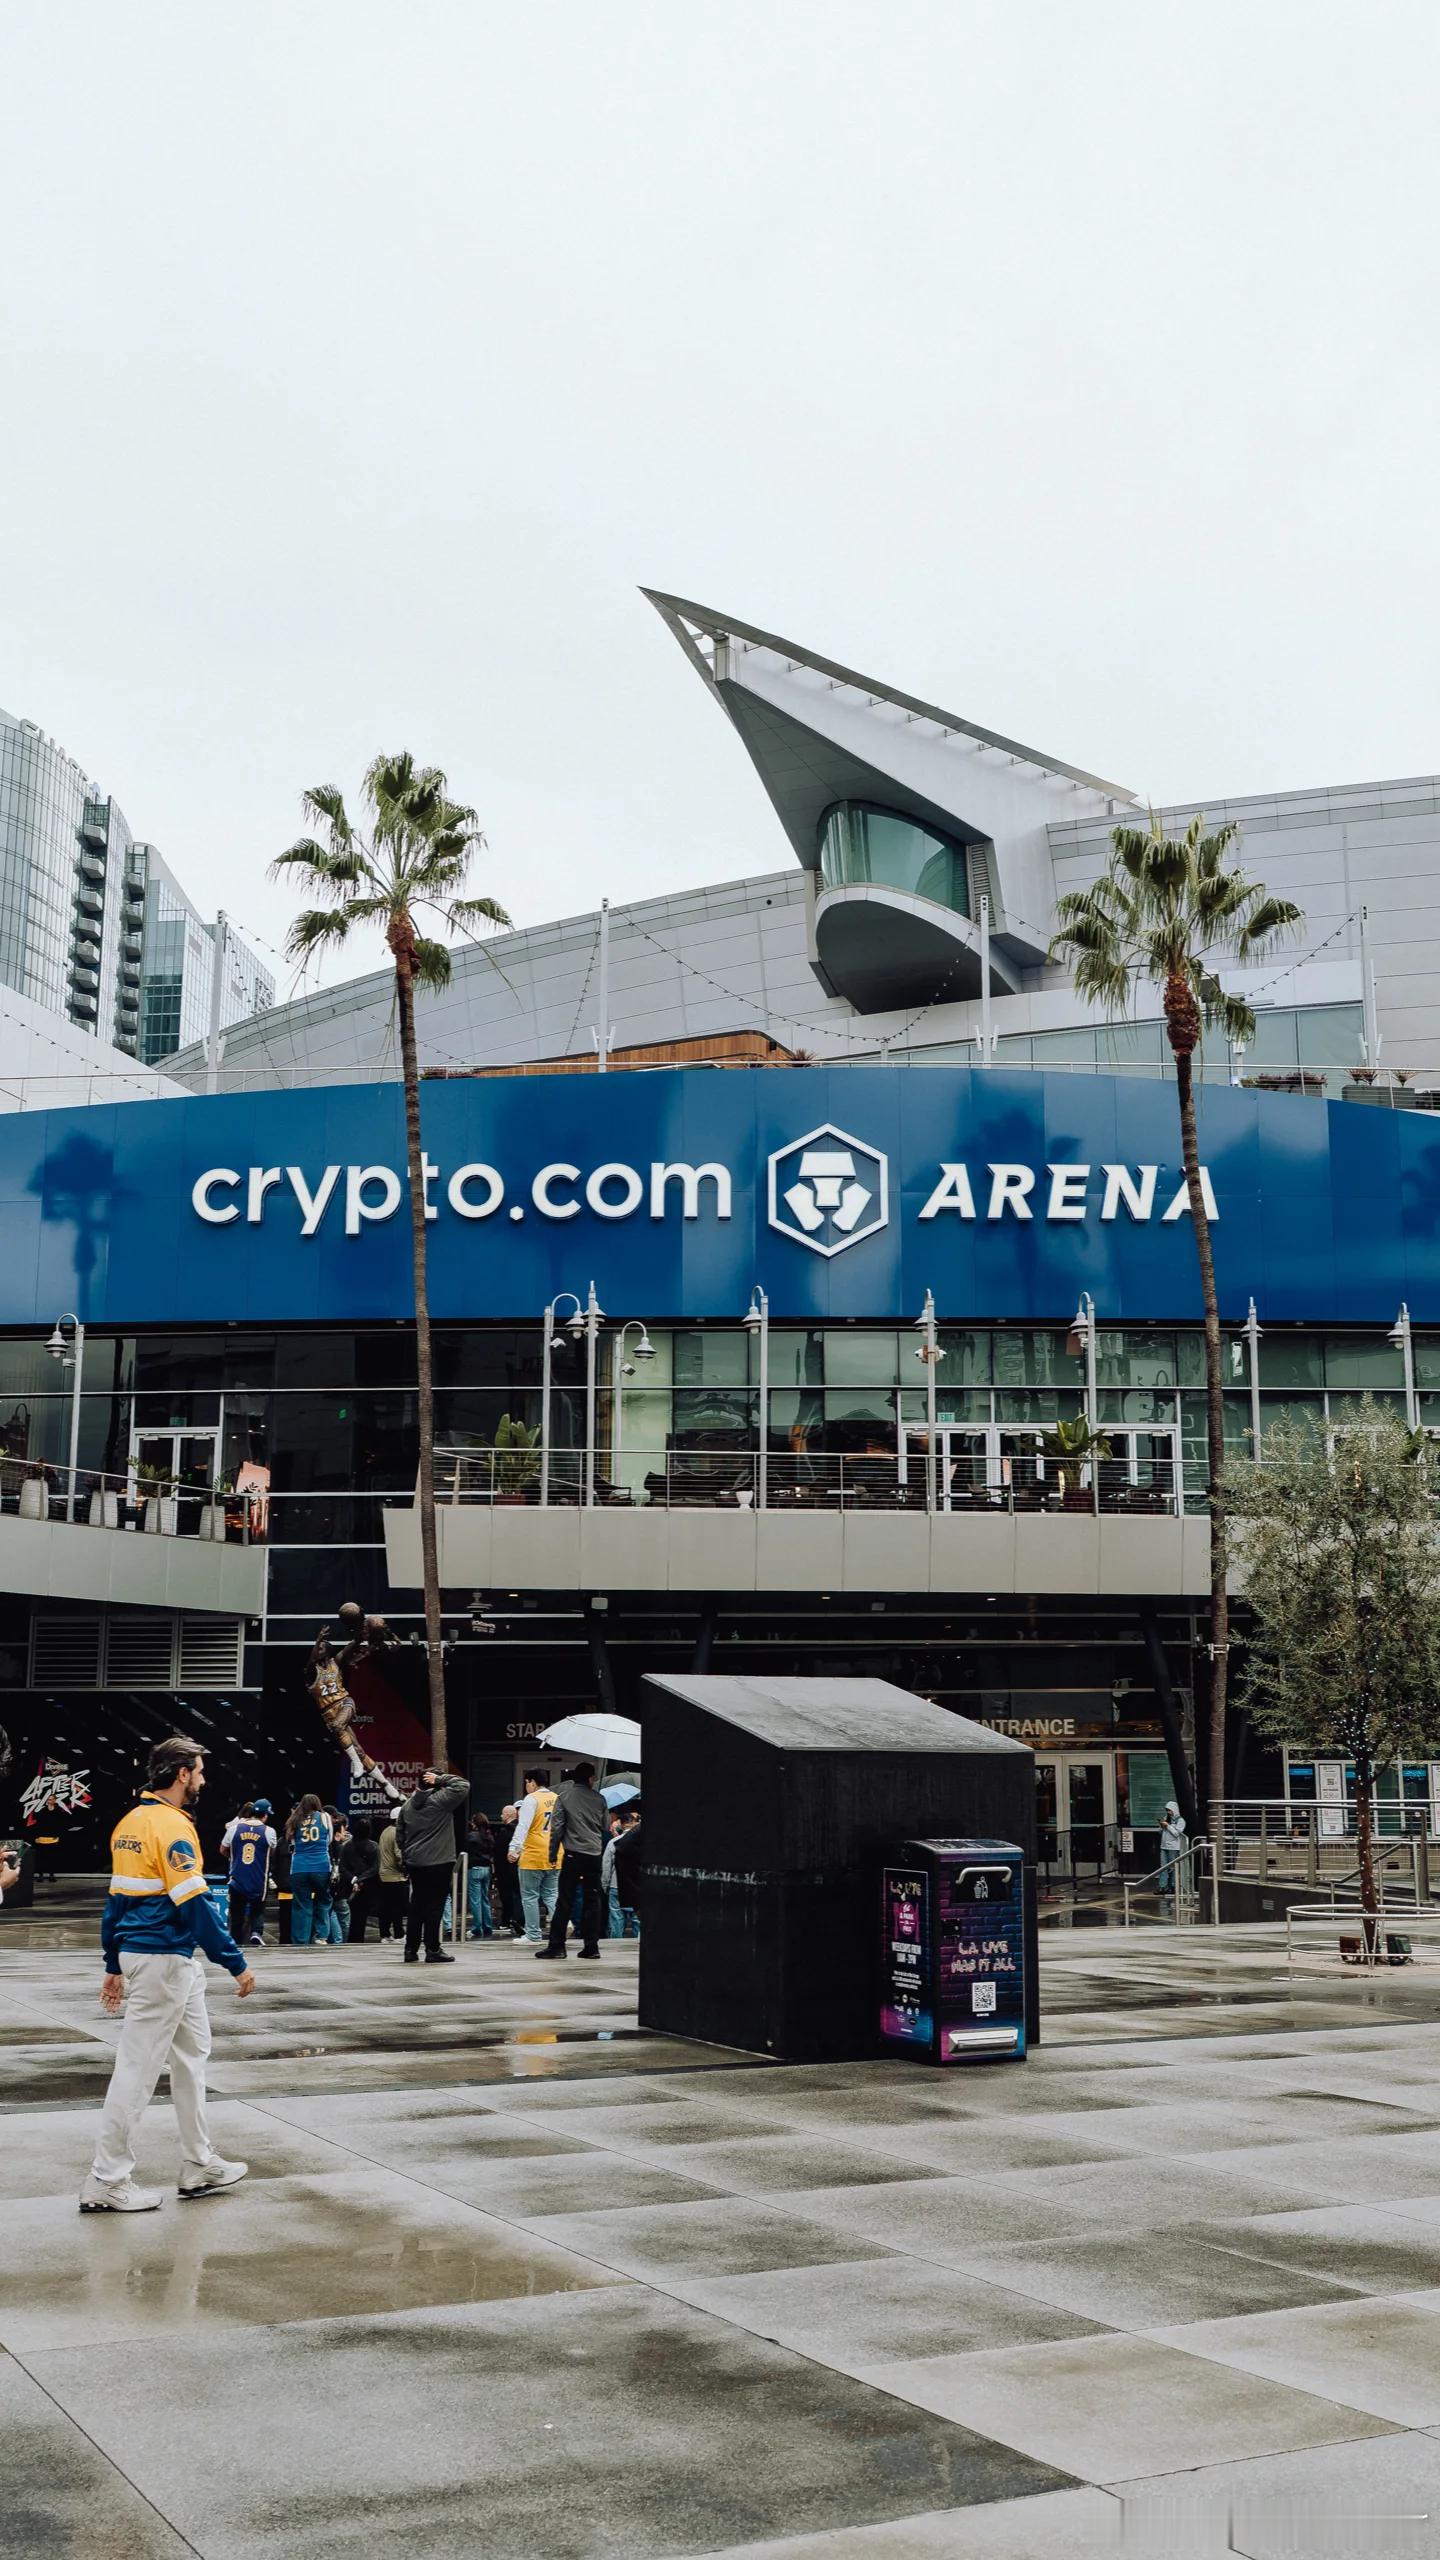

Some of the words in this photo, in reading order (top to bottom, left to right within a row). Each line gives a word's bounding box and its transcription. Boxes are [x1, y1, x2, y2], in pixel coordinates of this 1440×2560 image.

[191, 1151, 732, 1236] crypto.com
[917, 1162, 1220, 1222] ARENA
[320, 1682, 338, 1696] 22
[976, 1718, 1076, 1735] NTRANCE
[543, 1811, 553, 1832] 7
[301, 1826, 319, 1842] 30
[242, 1843, 256, 1865] 8
